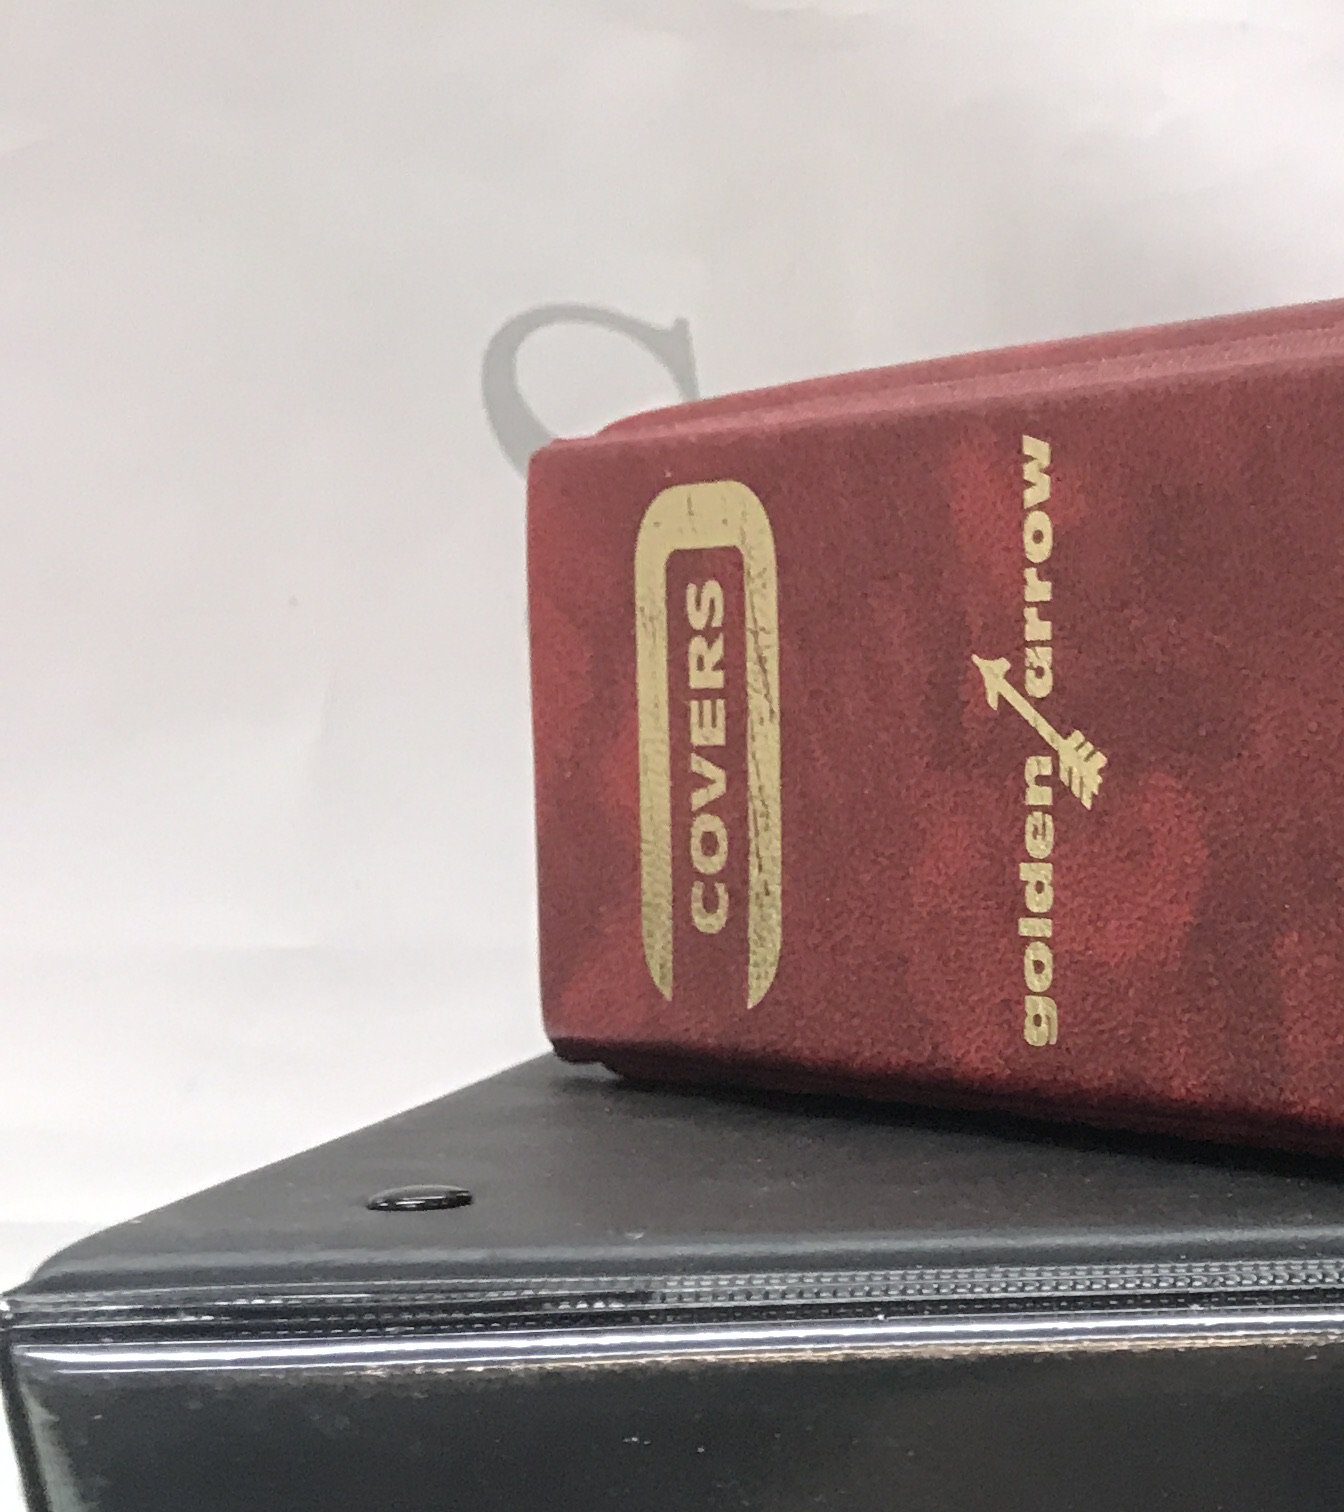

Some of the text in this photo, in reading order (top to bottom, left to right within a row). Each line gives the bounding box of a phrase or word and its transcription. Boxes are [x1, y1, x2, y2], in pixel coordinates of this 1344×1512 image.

[685, 579, 730, 935] COVERS
[1018, 434, 1058, 1047] golden arrow
